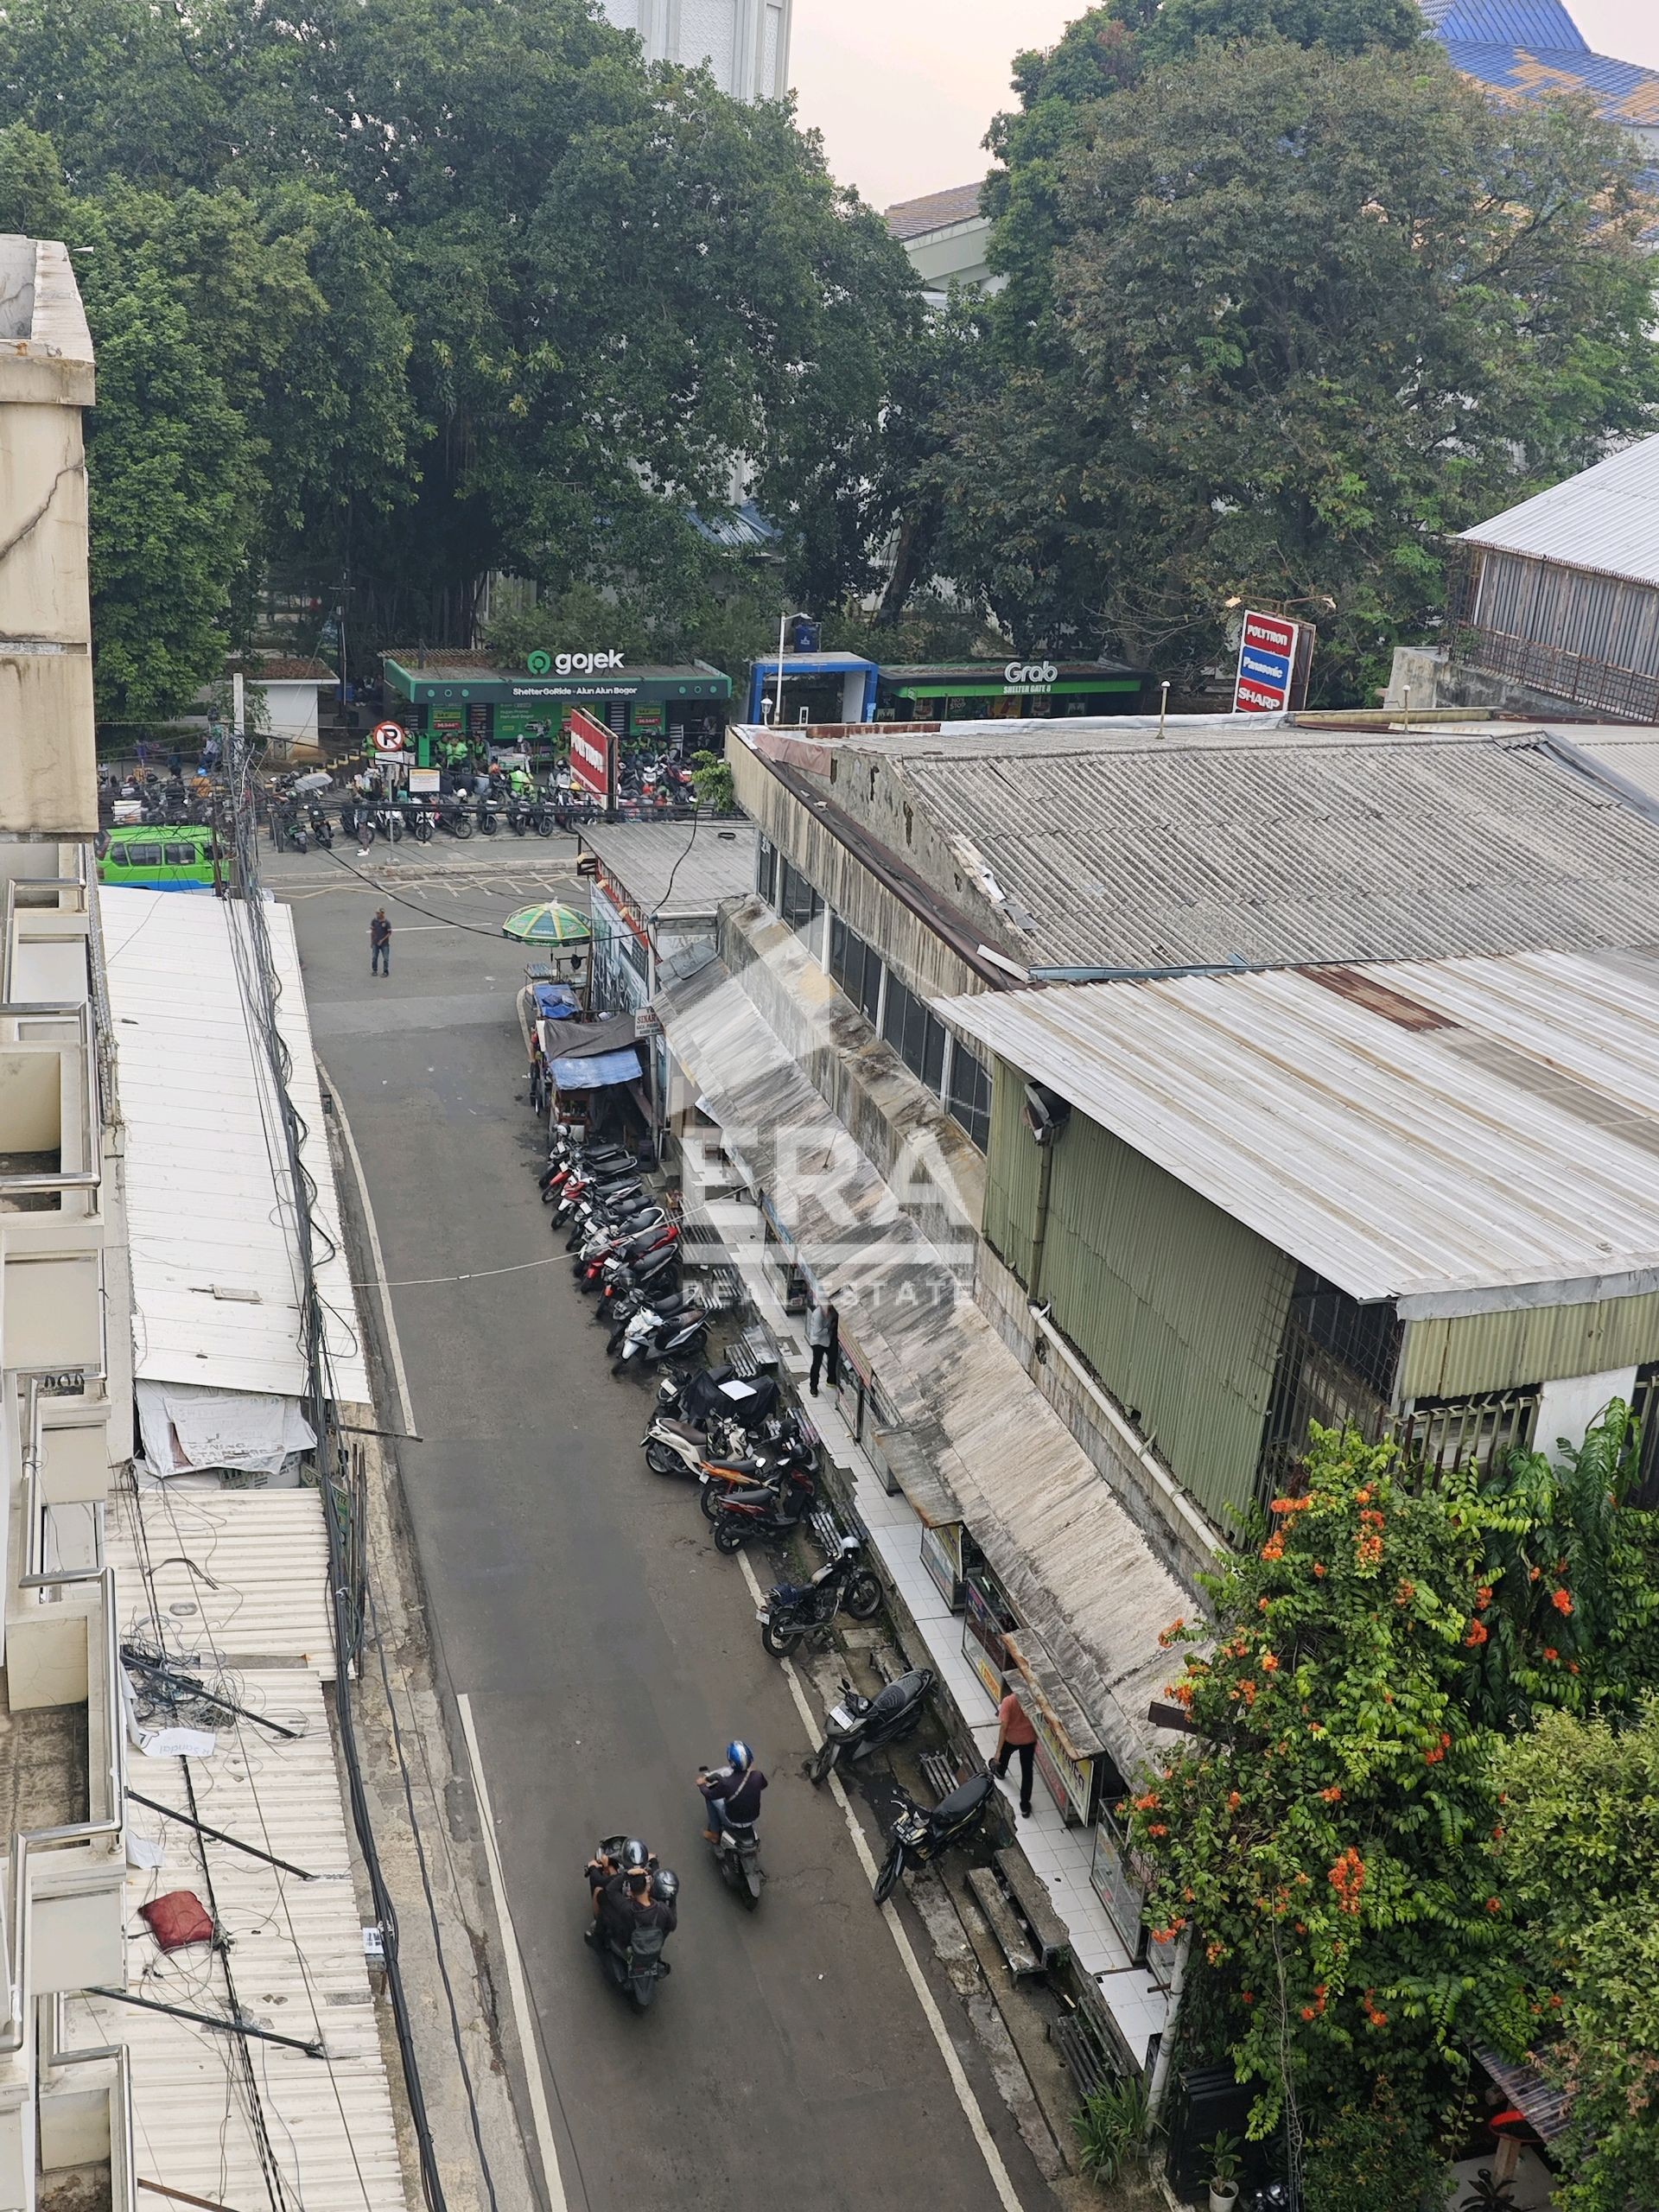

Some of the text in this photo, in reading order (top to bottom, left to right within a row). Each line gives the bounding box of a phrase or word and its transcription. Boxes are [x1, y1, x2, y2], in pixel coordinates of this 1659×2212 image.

[1247, 625, 1288, 646] POLYTRON
[555, 649, 625, 675] gojek
[1004, 660, 1058, 683] Grab
[1243, 656, 1283, 679] Panasonic
[576, 687, 594, 696] Alun
[595, 687, 613, 696] Alun
[613, 687, 637, 696] Bogor
[1003, 685, 1029, 694] SHELTER
[1030, 684, 1046, 693] GATE
[1237, 687, 1281, 710] SHARP
